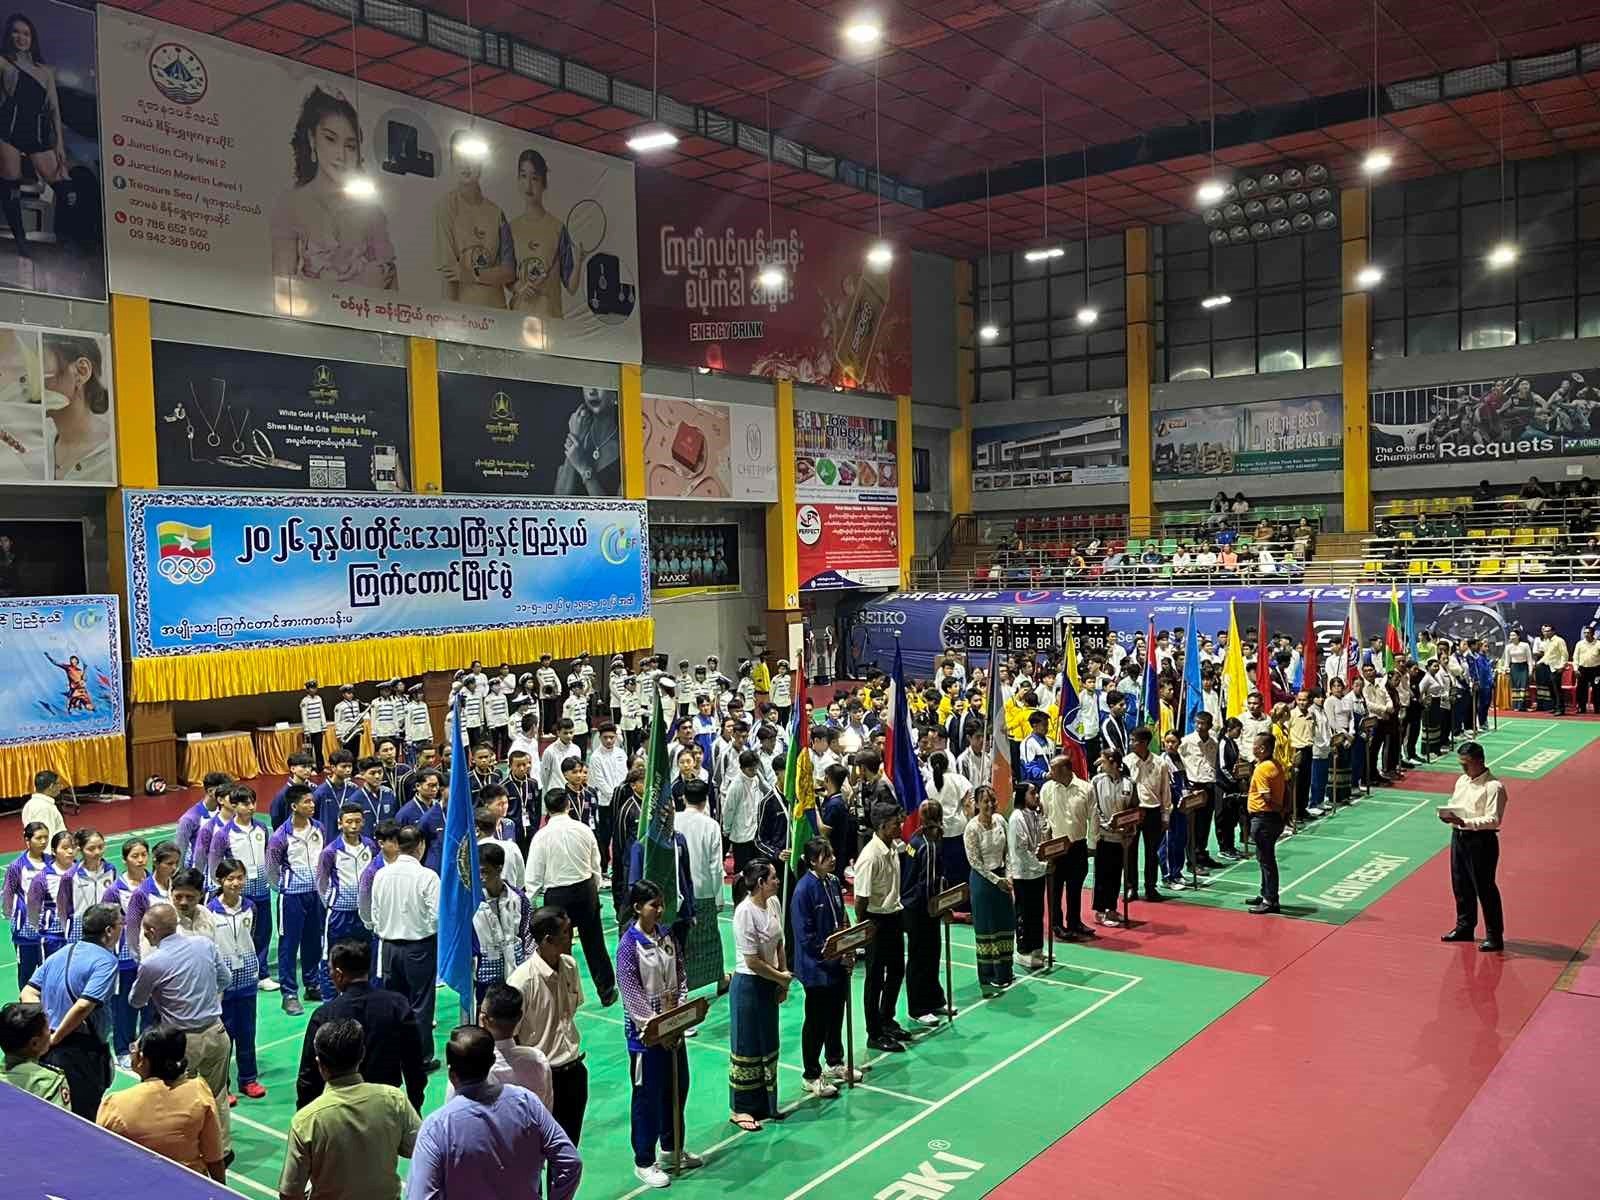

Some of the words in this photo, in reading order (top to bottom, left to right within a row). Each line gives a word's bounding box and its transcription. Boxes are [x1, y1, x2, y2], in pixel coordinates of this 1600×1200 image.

[127, 138, 171, 157] Junction
[173, 148, 193, 163] City
[220, 160, 226, 169] 2
[128, 158, 172, 177] Junction
[212, 177, 237, 192] Level
[128, 178, 171, 196] Treasure
[173, 188, 193, 201] Sea
[129, 215, 144, 226] 09
[129, 230, 144, 241] 09
[691, 324, 730, 339] ENERGY
[731, 322, 763, 338] DRINK
[1298, 411, 1320, 430] BEST
[1296, 431, 1323, 448] BEAST
[1577, 438, 1600, 449] YONE
[1376, 446, 1393, 454] The
[1419, 443, 1436, 451] For
[1439, 437, 1554, 459] Racquets
[1375, 452, 1436, 462] Champions
[349, 560, 513, 608] ကြက်တောင်ပြိုင်ပွဲ
[658, 574, 687, 582] MAXX
[1062, 589, 1165, 598] CHERRY
[854, 611, 907, 625] SEIKO
